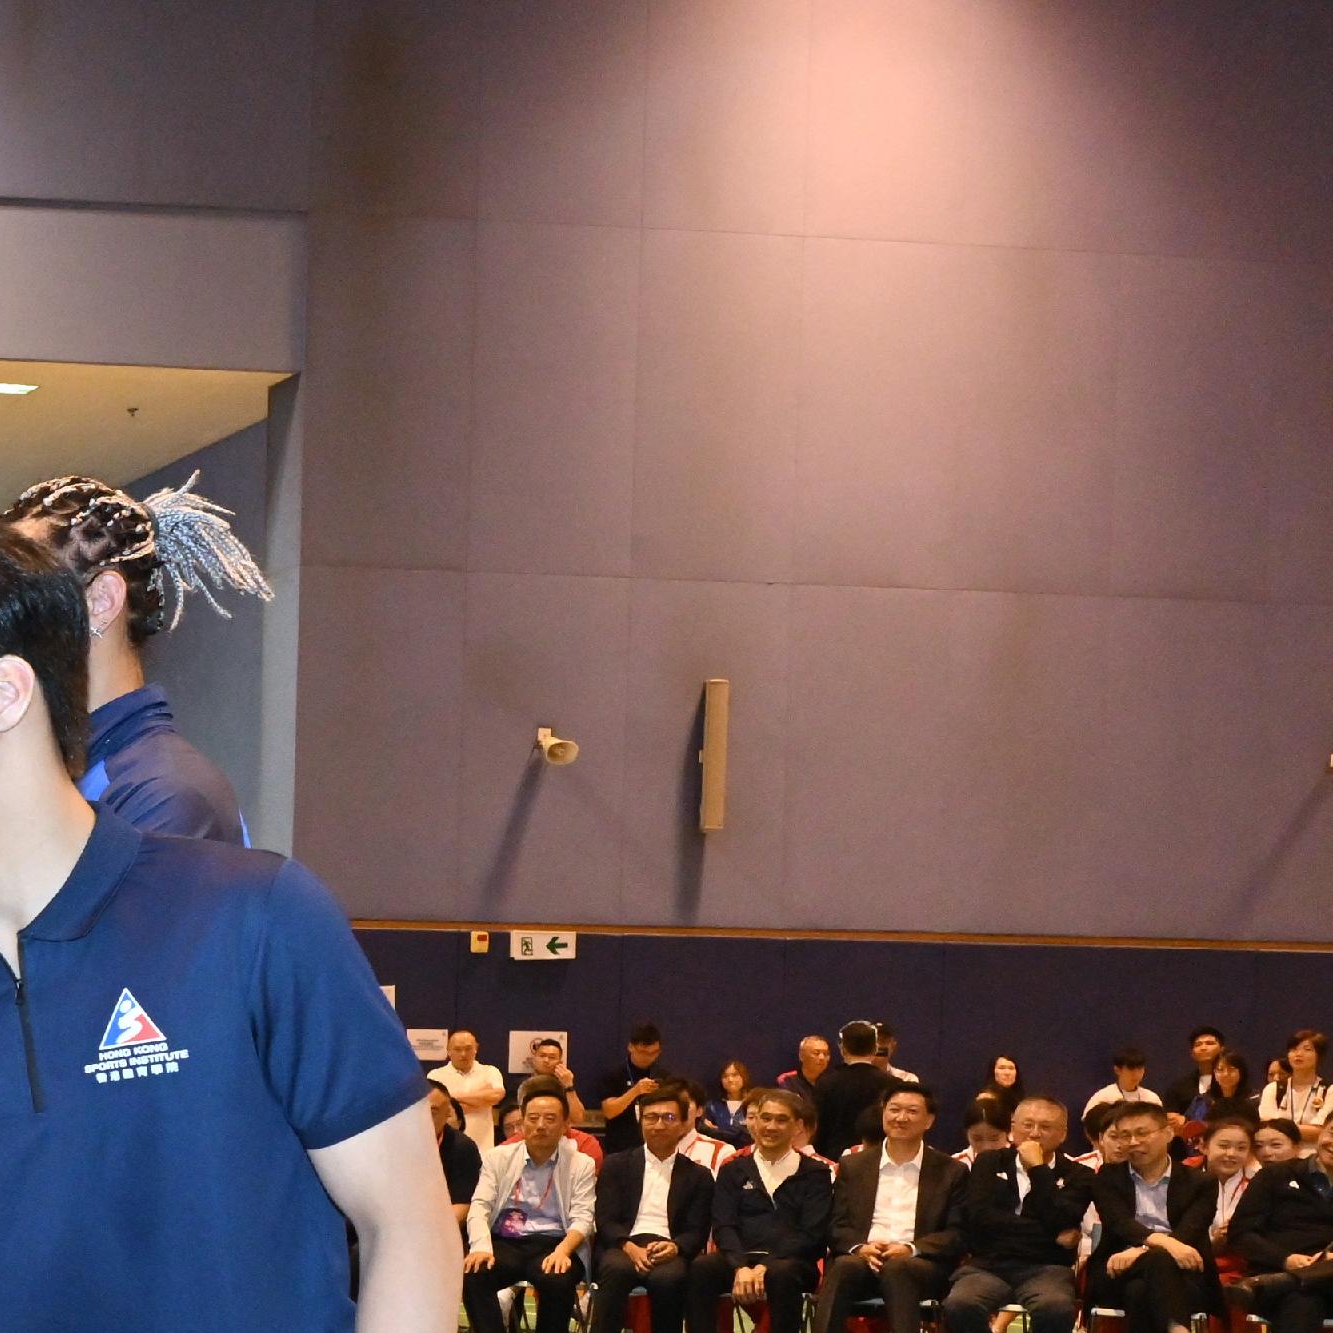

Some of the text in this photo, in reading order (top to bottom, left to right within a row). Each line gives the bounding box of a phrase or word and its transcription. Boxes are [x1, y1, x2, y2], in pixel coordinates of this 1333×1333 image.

[84, 1059, 128, 1073] SPORTS
[129, 1049, 189, 1066] INSTITUTE
[99, 1042, 168, 1061] HONG KONG
